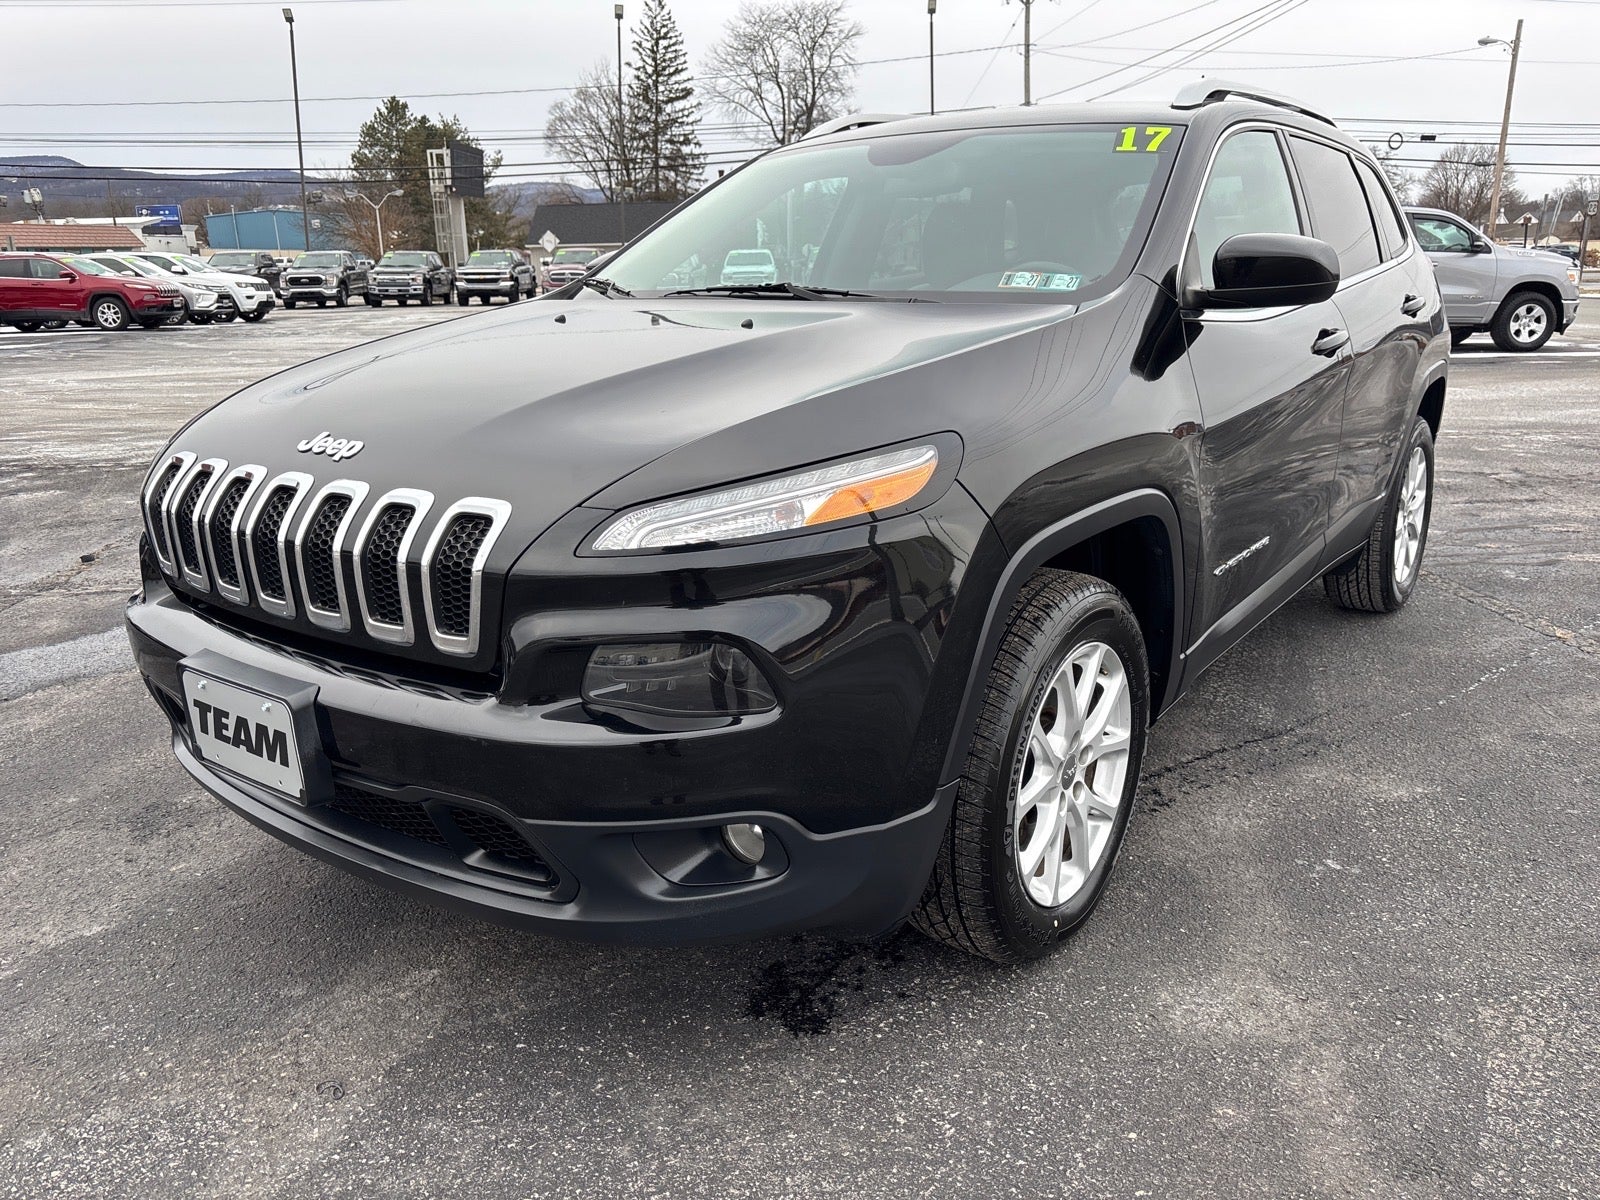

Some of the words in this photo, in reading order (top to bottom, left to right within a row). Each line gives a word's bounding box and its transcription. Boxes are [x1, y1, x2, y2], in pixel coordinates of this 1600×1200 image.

[1115, 126, 1172, 152] 17
[296, 431, 365, 463] Jeep
[192, 698, 290, 768] TEAM
[1008, 683, 1045, 802] DESTINATION
